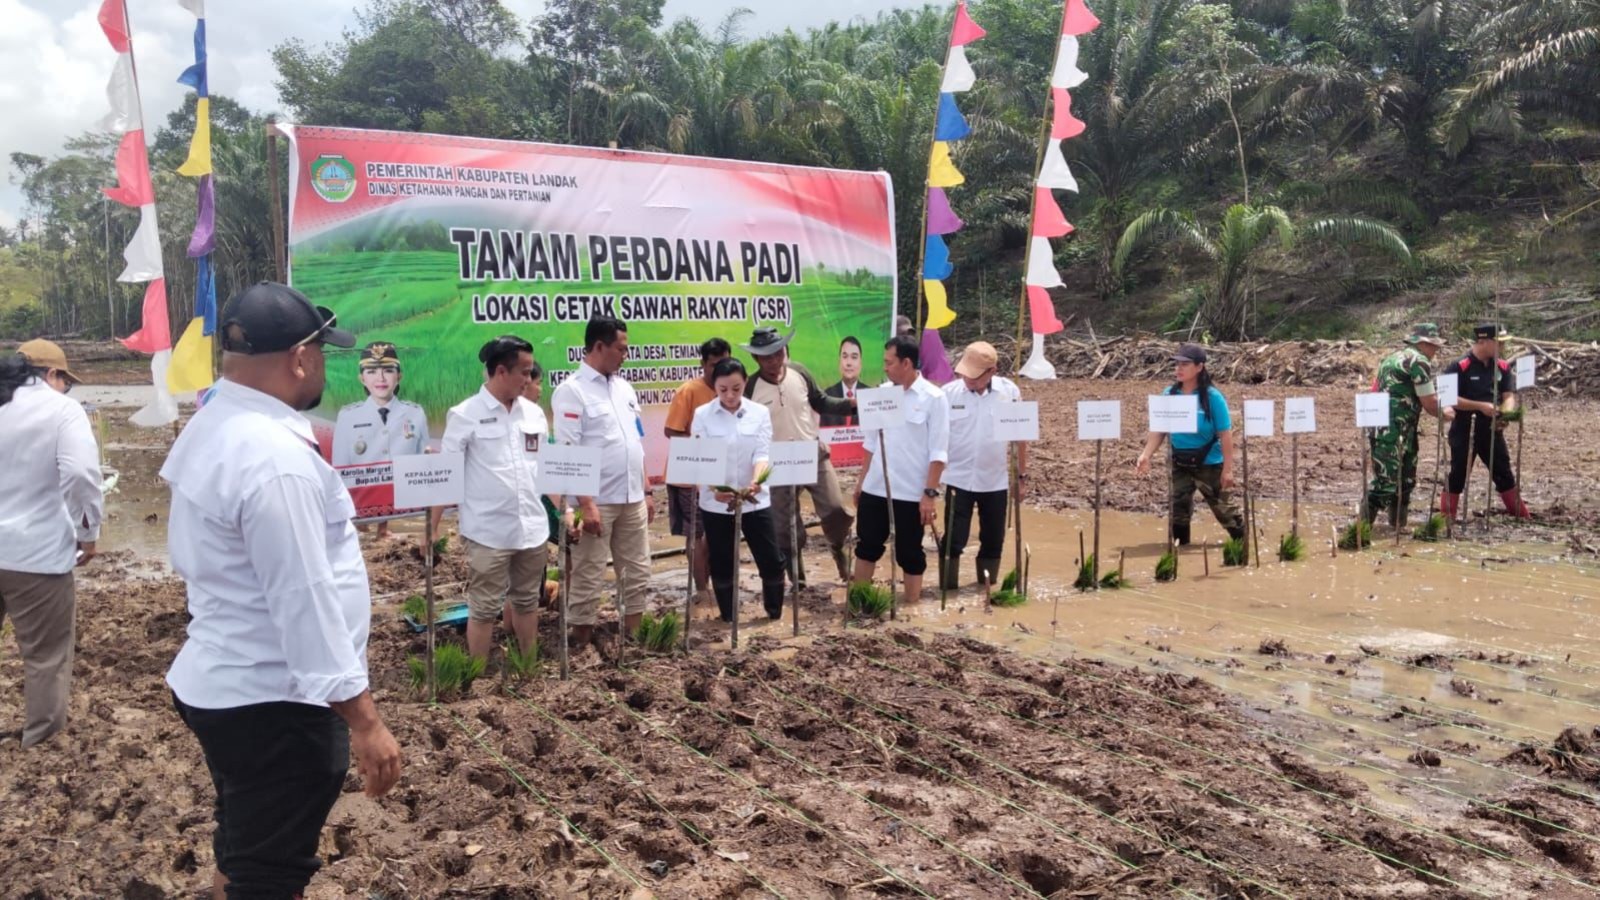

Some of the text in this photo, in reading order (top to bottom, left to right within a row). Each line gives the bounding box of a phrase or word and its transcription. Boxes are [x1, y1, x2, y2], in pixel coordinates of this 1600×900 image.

[366, 162, 578, 189] PEMERINTAH KABUPATEN LANDAK
[369, 182, 552, 202] DINAS KETAHANAN PANGAN DAN PERTANIAN
[451, 228, 802, 286] TANAM PERDANA PADI
[473, 295, 793, 326] LOKASI CETAK SAWAH RAKYAT (CSR)
[568, 347, 587, 362] DUS
[643, 345, 667, 360] DESA
[669, 345, 702, 360] TEMIAN
[617, 366, 705, 382] GABANG KABUPATE
[341, 468, 365, 477] Karolin
[404, 471, 433, 479] KEPALA
[355, 476, 380, 486] Bupati
[407, 477, 449, 486] PONTIANAK
